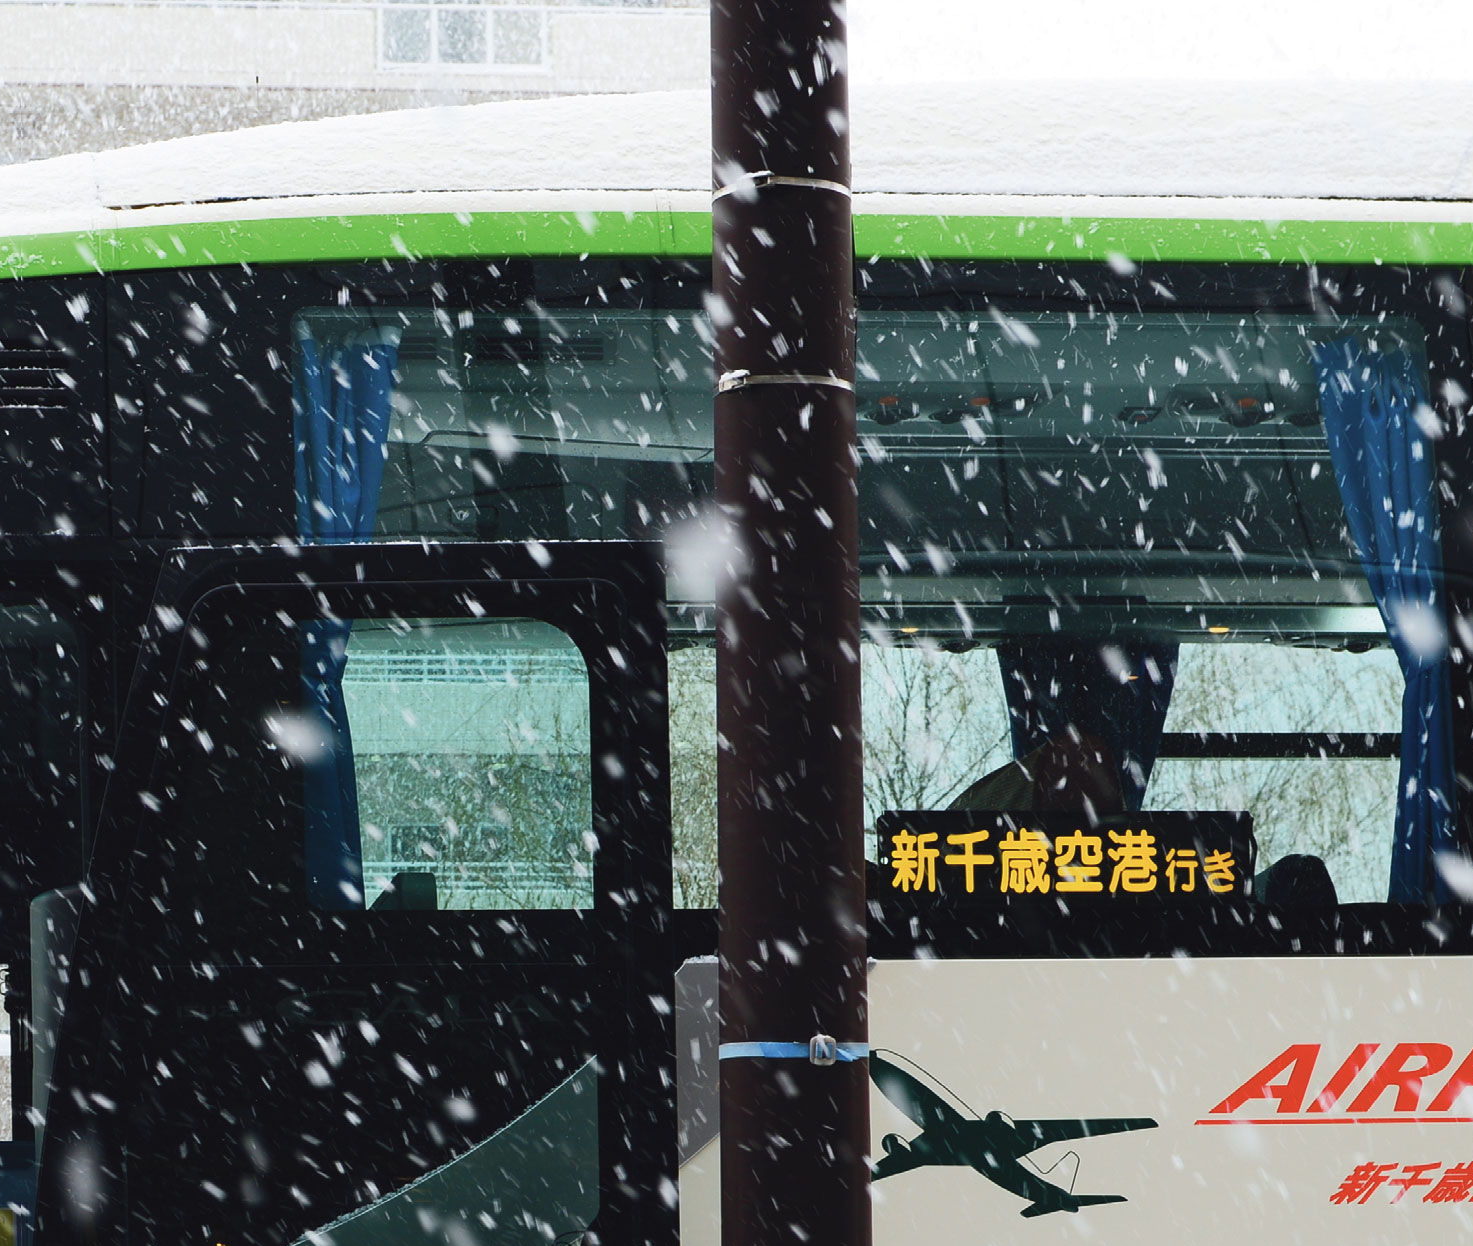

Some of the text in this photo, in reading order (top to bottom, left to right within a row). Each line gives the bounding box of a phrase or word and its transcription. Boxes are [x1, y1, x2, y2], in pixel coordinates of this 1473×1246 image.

[890, 828, 1236, 894] 新千歳空港行き
